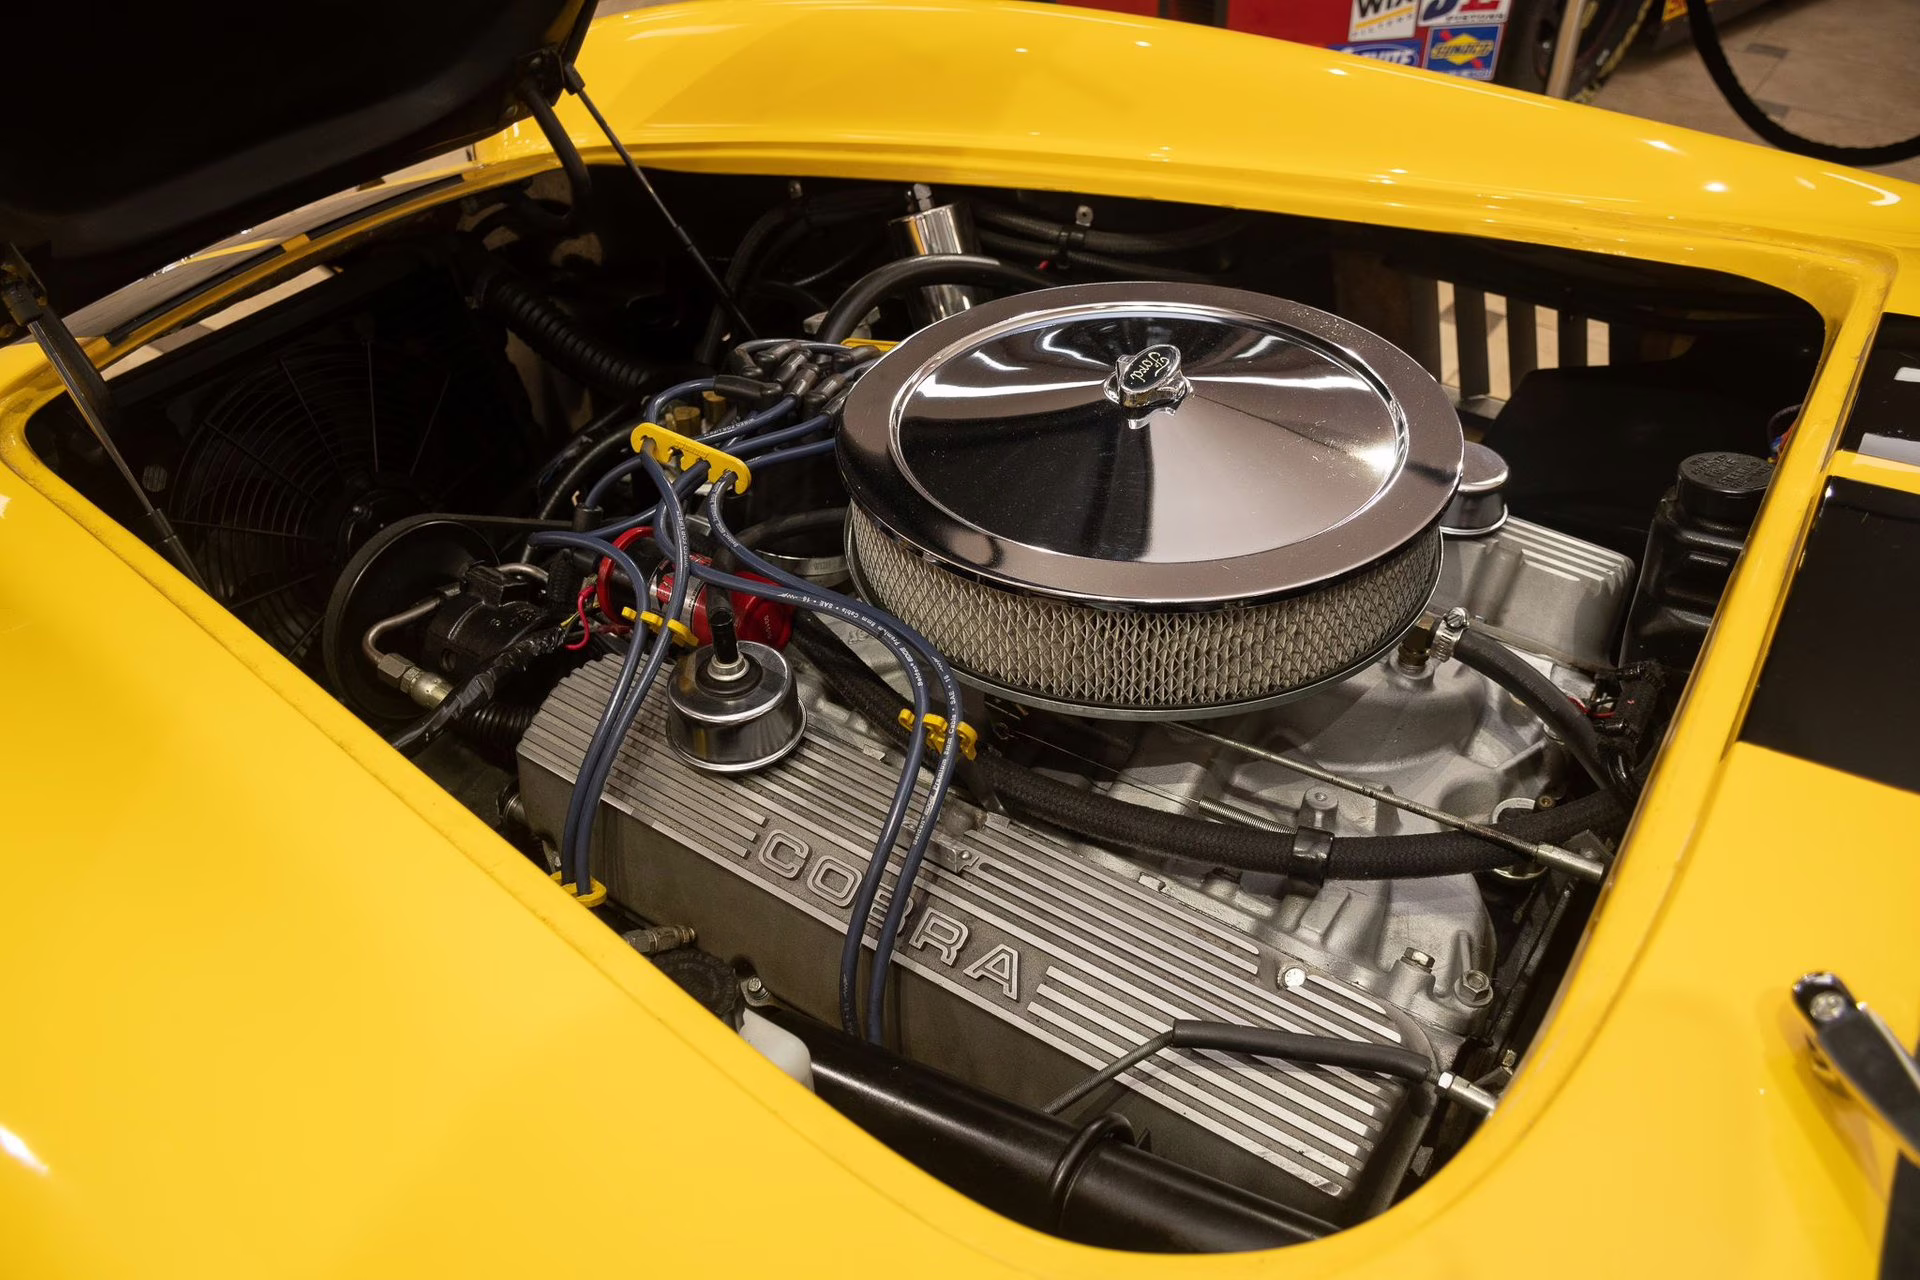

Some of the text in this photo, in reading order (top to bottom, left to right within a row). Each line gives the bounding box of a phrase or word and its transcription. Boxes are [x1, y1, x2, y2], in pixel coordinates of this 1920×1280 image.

[1130, 352, 1169, 382] Ford
[819, 600, 833, 609] SAE
[842, 607, 859, 619] Cable
[861, 616, 876, 628] 8mm
[876, 625, 901, 646] Premium
[949, 690, 957, 705] SAE
[949, 714, 957, 734] Cable
[943, 737, 953, 755] 8mm
[933, 758, 947, 790] Premium
[758, 829, 1020, 1002] COBRA
